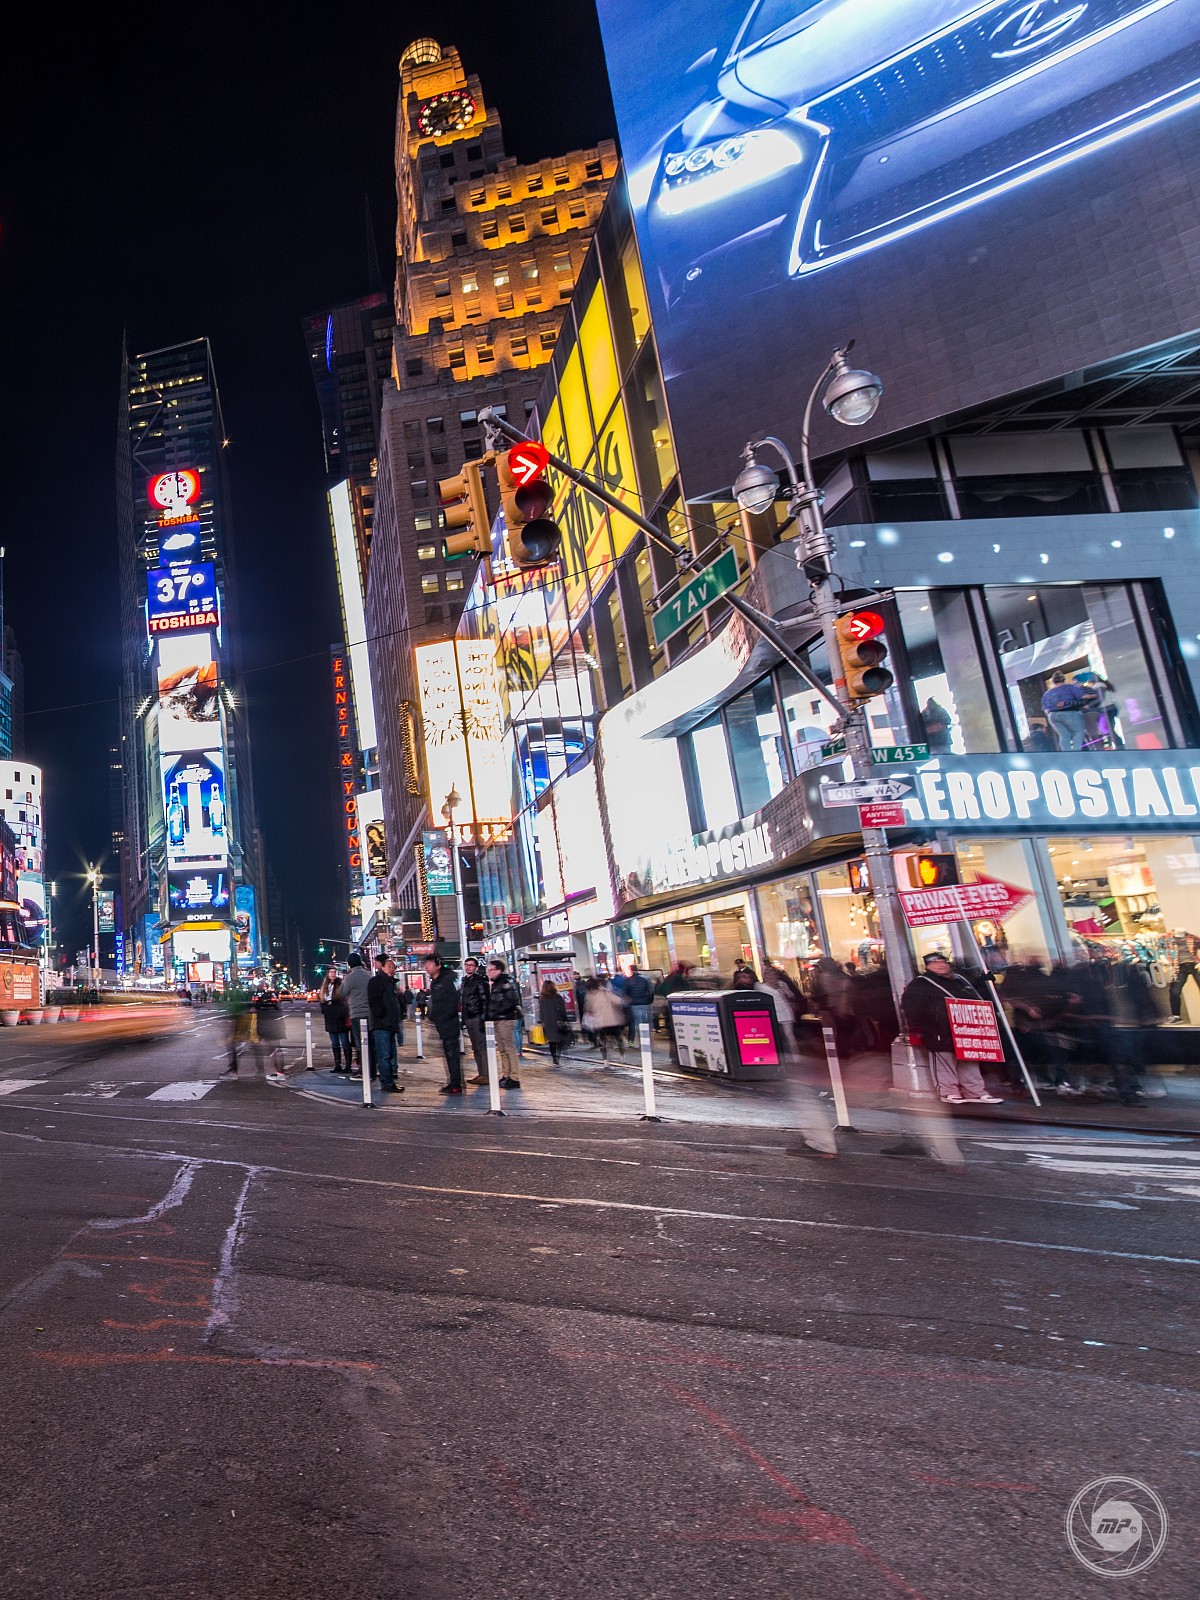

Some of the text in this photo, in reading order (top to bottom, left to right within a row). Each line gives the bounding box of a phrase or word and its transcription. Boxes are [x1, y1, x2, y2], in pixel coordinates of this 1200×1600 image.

[158, 514, 200, 527] TOSHIBA
[157, 573, 205, 603] 37°
[672, 582, 708, 622] 7 Av
[149, 612, 217, 631] TOSHIBA
[333, 659, 361, 867] ERNST & YOUNG
[872, 746, 927, 763] W 45 St
[835, 784, 902, 799] ONE WAY
[866, 811, 898, 819] ANYTIME
[872, 803, 901, 811] STANDING
[904, 883, 1010, 912] PRIVATE EYES
[186, 913, 214, 922] SONY
[912, 916, 924, 924] 320
[925, 915, 944, 924] WEST
[944, 912, 961, 921] 45TH
[949, 1003, 995, 1026] PRIVATE EYES
